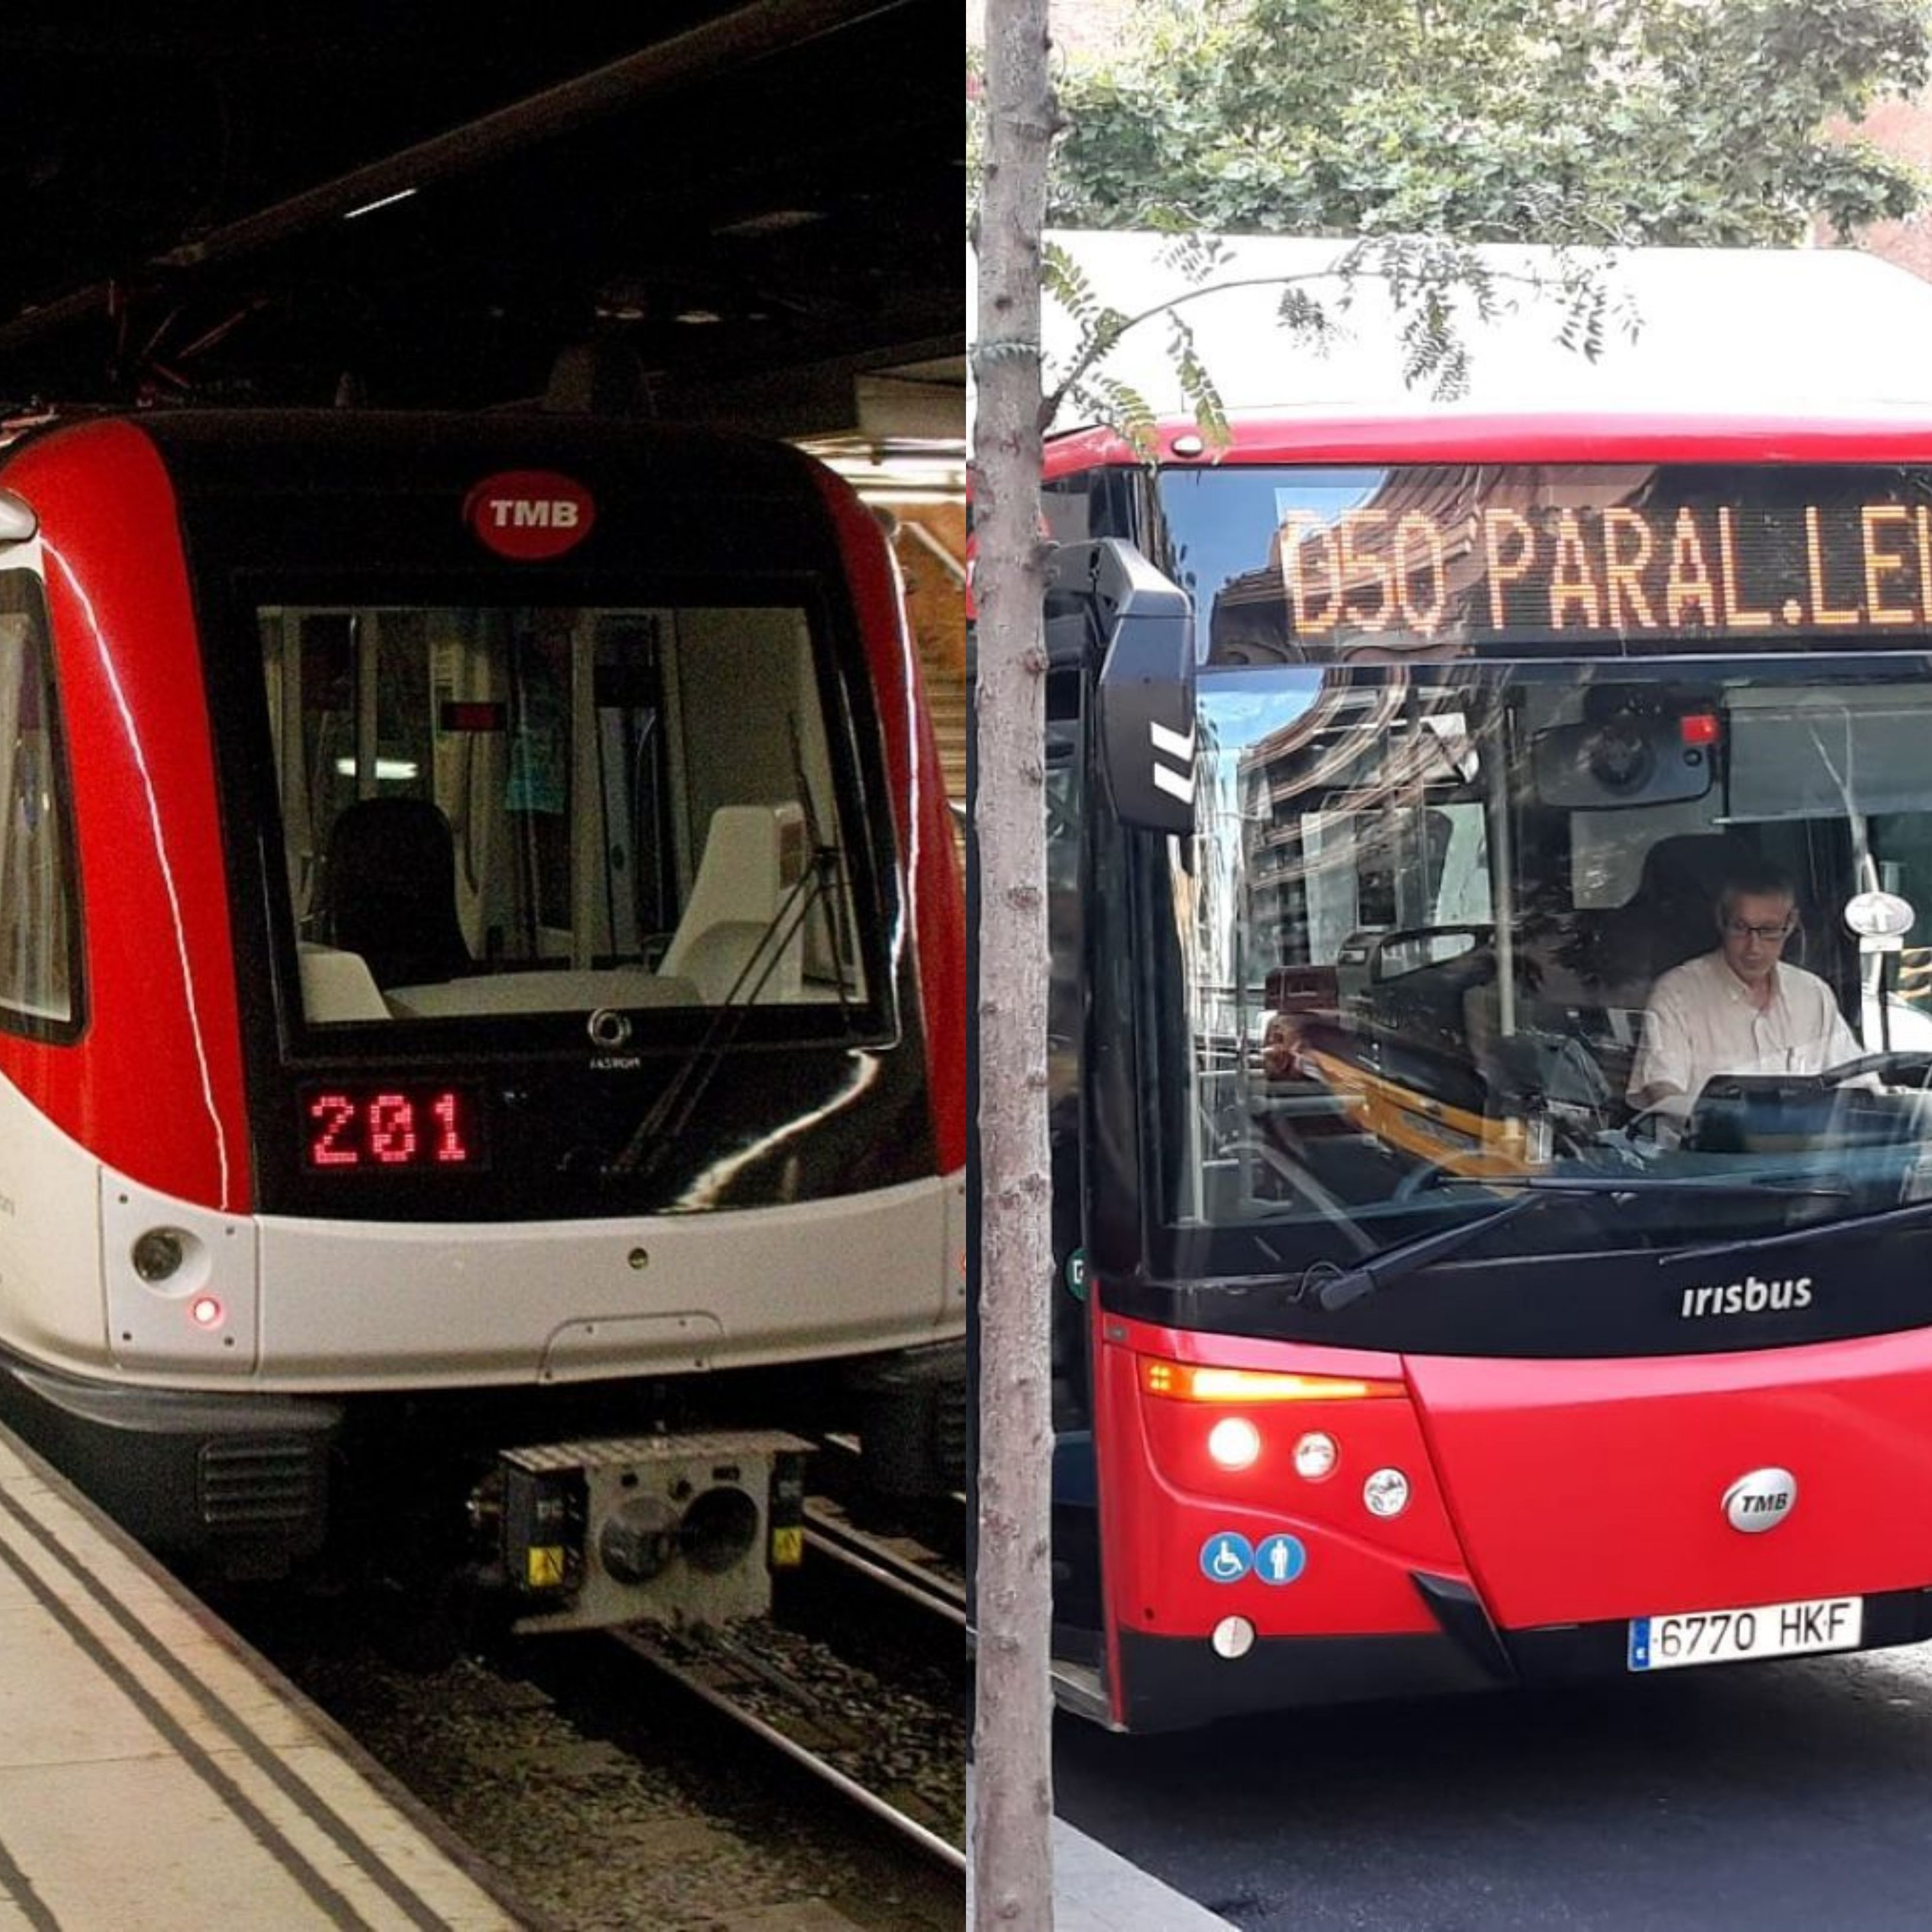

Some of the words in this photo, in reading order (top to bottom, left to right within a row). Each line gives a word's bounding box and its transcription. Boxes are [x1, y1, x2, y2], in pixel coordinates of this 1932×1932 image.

[491, 500, 579, 528] TMB
[311, 1094, 466, 1164] 201
[1681, 1276, 1812, 1318] irisbus
[1742, 1492, 1788, 1513] TMB
[1660, 1613, 1756, 1657] 6770
[1780, 1602, 1851, 1647] HKF
